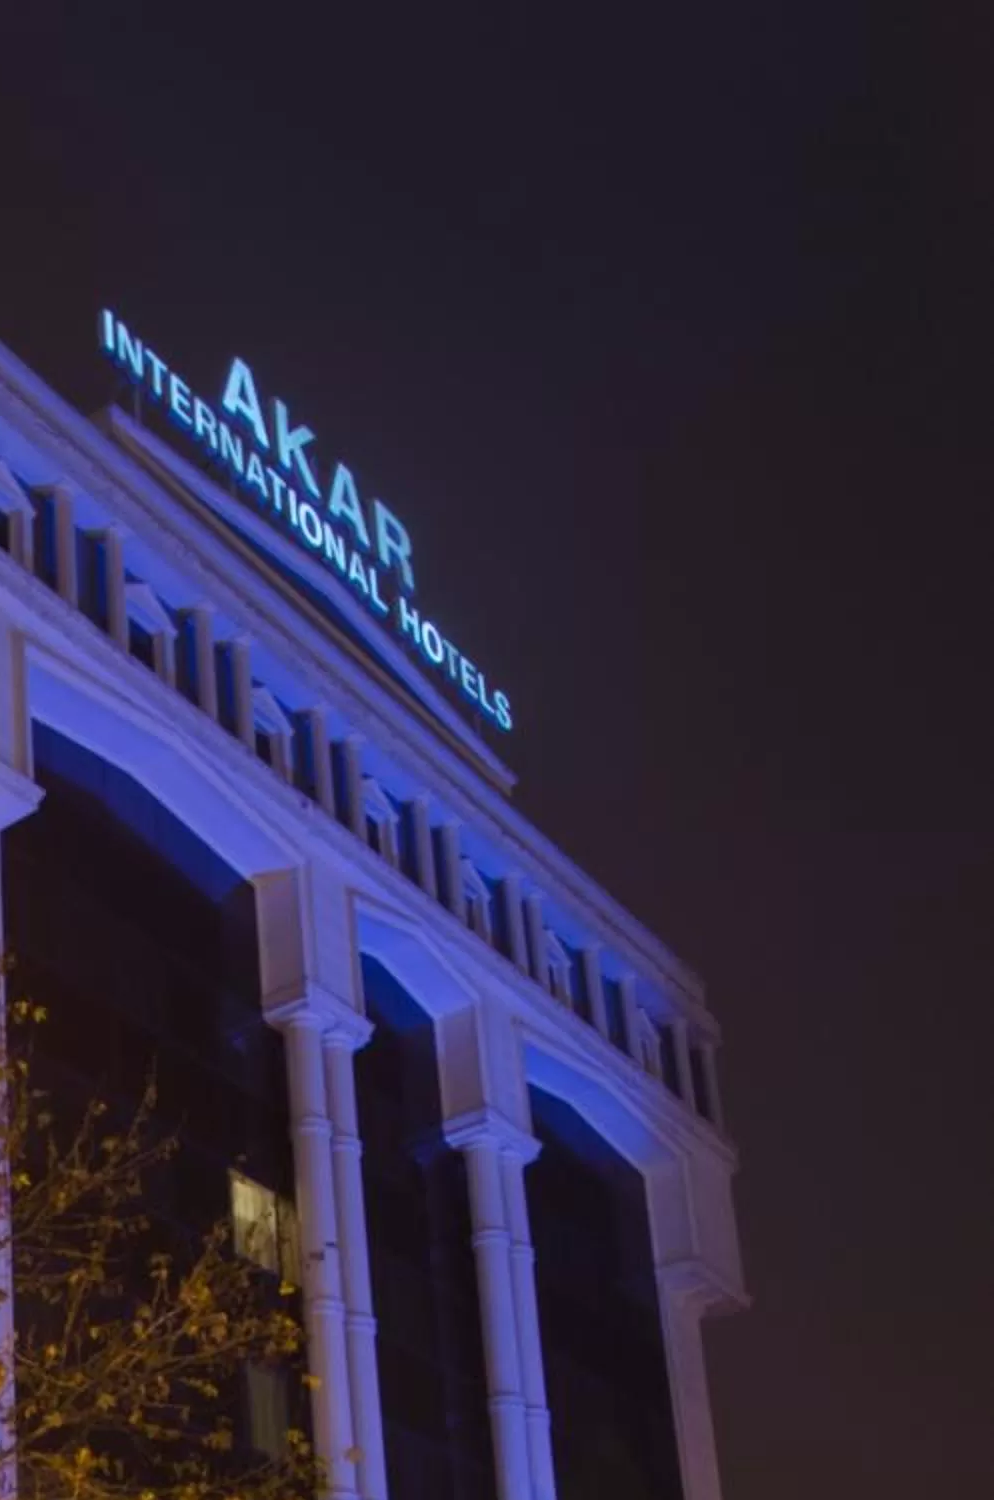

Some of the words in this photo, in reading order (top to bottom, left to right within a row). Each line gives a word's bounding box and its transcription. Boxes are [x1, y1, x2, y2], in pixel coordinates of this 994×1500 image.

[102, 307, 389, 615] INTERNATIONAL
[399, 595, 512, 731] HOTELS
[221, 355, 415, 590] AKAR
